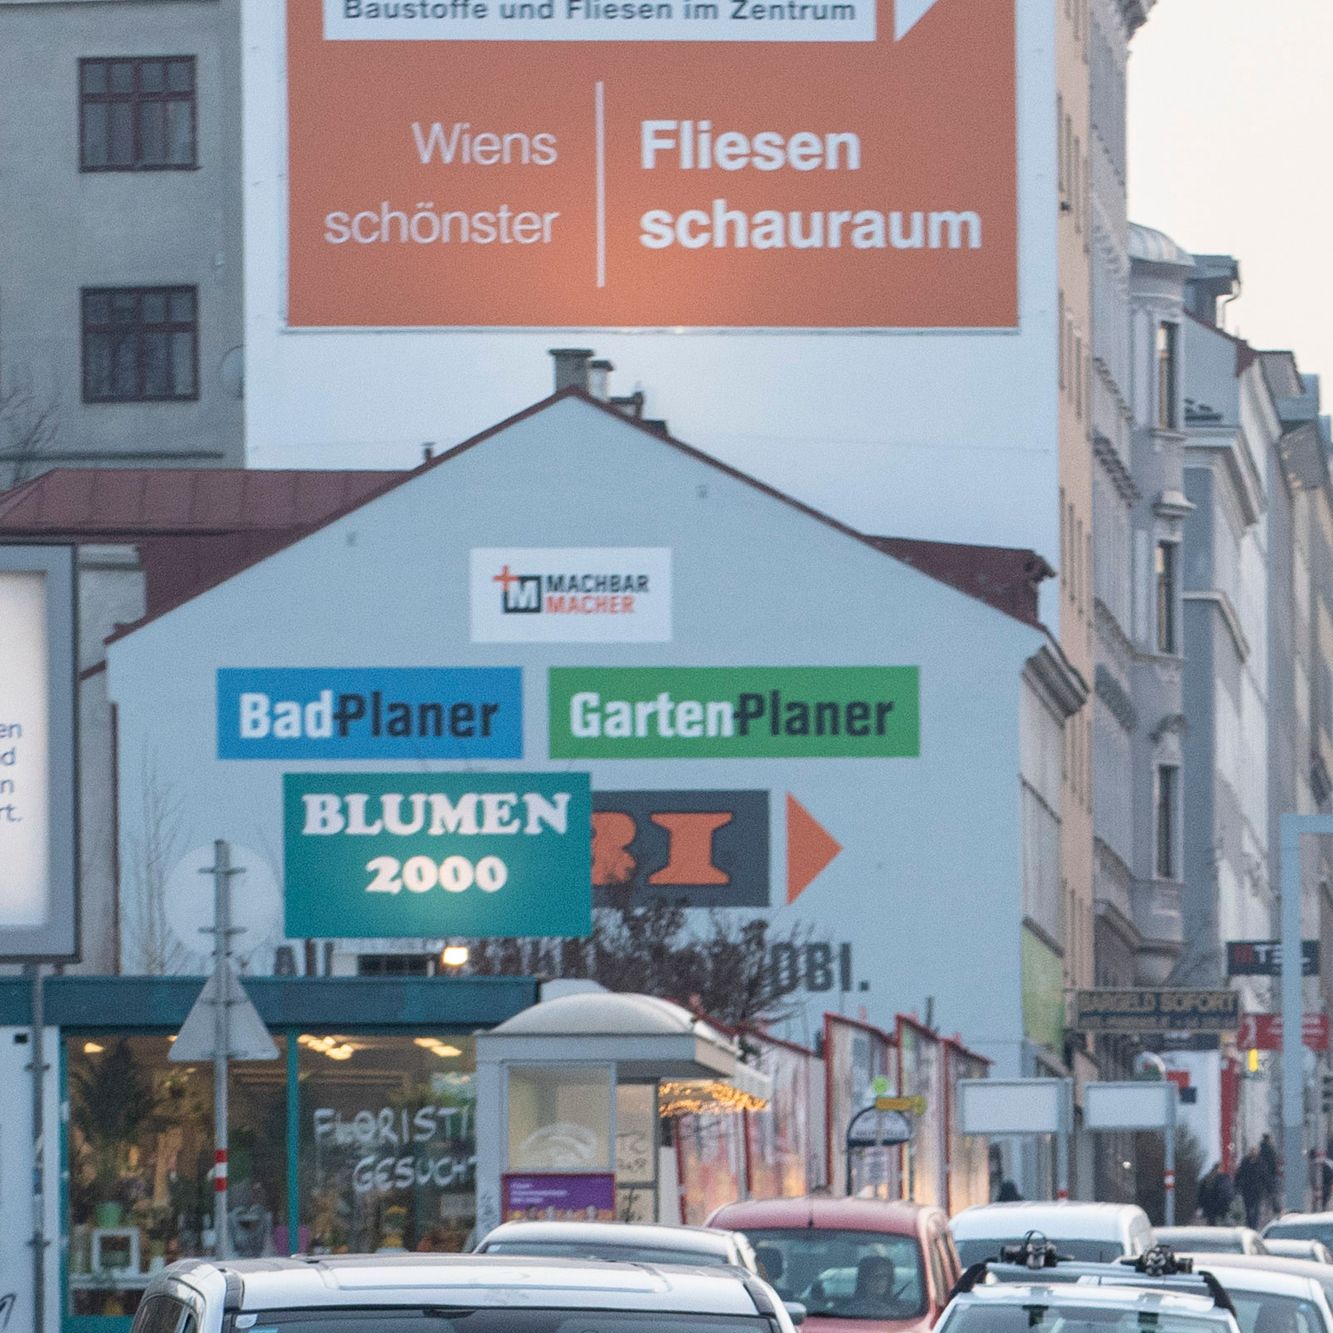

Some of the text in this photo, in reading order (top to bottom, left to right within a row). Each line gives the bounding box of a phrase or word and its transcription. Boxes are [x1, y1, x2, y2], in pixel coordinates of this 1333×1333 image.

[343, 0, 857, 21] Baustoffe und Fliesen im Zentrum
[411, 122, 559, 166] Wiens
[640, 120, 860, 171] Fliesen
[323, 201, 560, 247] schönster
[638, 200, 982, 250] schauraum
[546, 574, 650, 593] MACHBAR
[545, 596, 636, 614] MACHER
[302, 792, 571, 836] BLUMEN
[365, 855, 508, 894] 2000
[312, 1105, 477, 1145] FLORISTI
